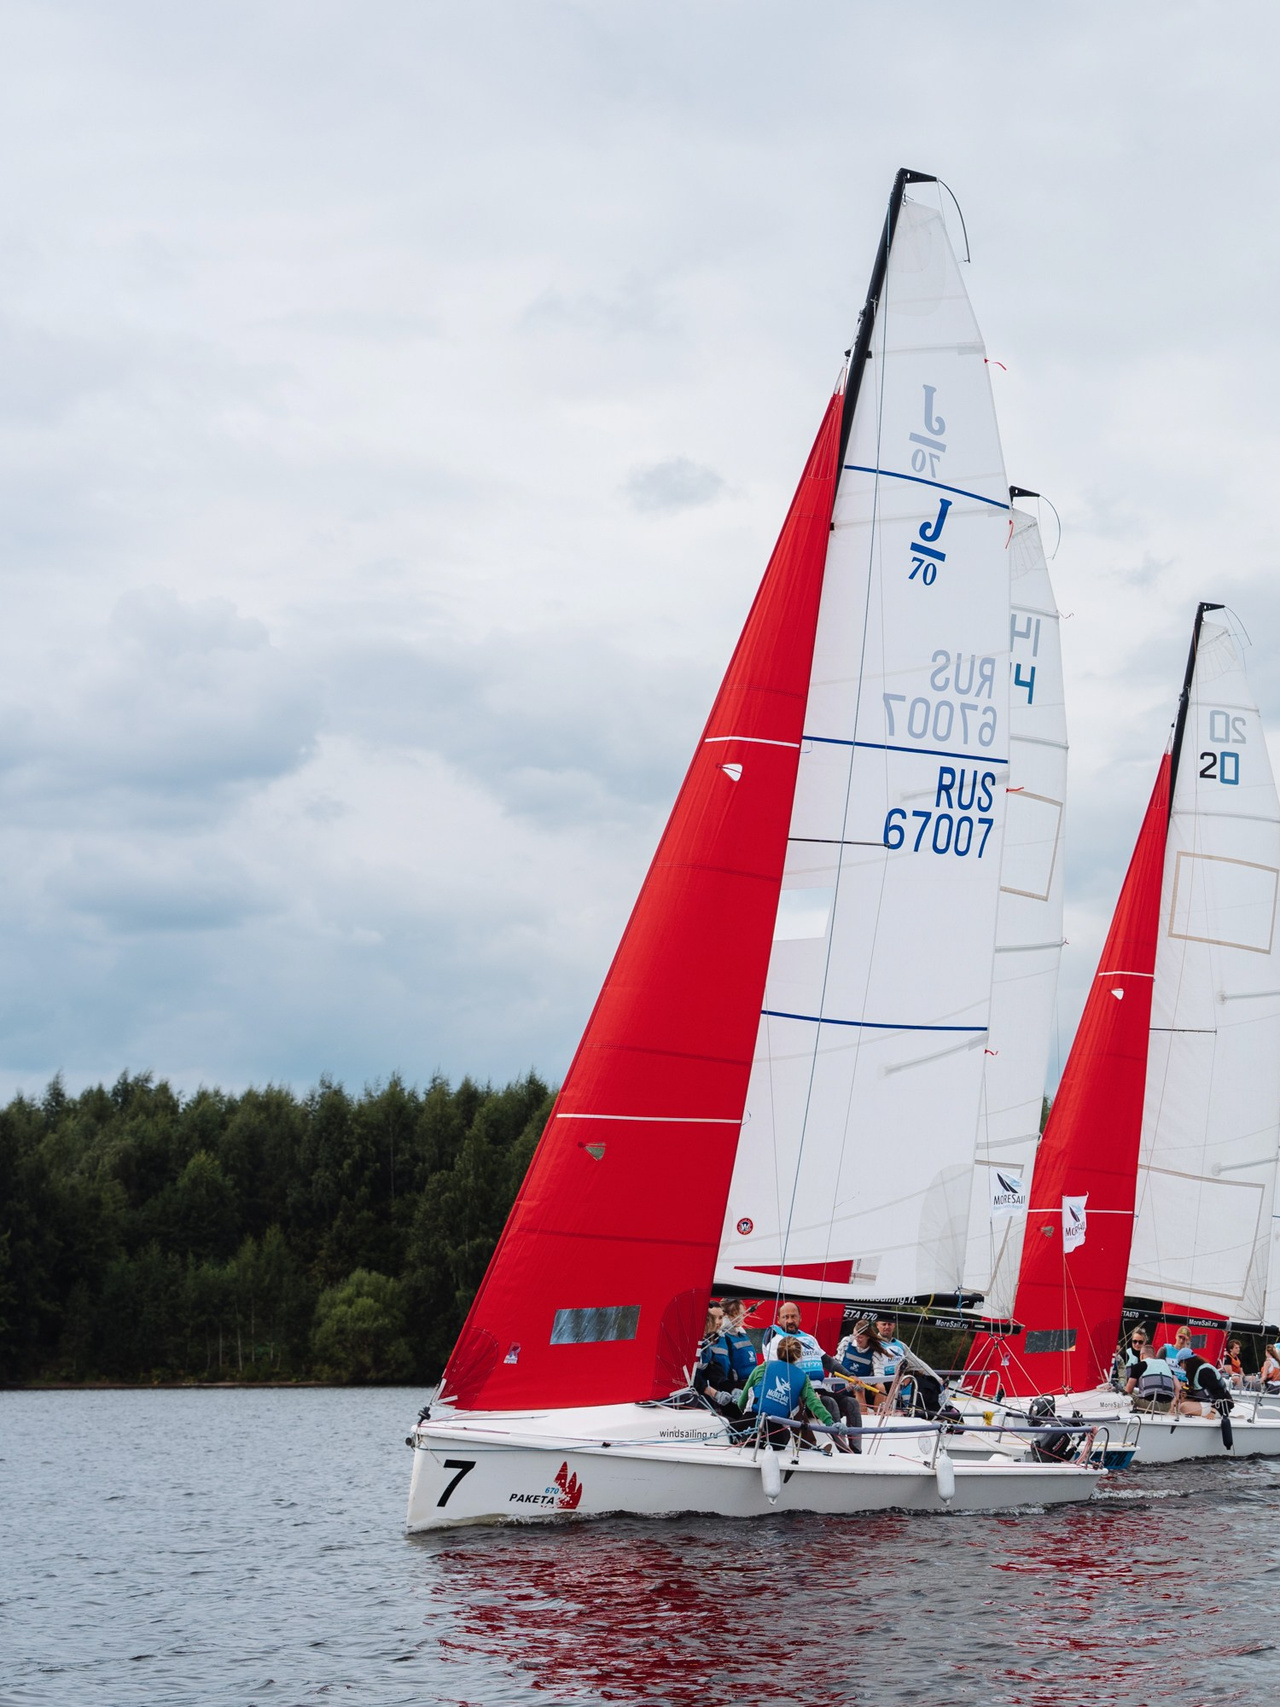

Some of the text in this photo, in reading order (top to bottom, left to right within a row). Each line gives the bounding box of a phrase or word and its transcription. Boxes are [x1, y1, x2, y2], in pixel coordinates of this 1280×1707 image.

[918, 498, 951, 542] J
[908, 556, 937, 586] 70
[1010, 662, 1036, 704] 4
[1199, 751, 1240, 786] 20
[935, 765, 997, 813] RUS
[884, 808, 995, 859] 67007
[843, 1308, 879, 1321] ЕТА 670
[935, 1319, 969, 1329] MoreSail.ru
[1188, 1318, 1218, 1328] MoreSail.ru
[659, 1428, 719, 1440] windsailingru
[436, 1459, 476, 1507] 7
[544, 1486, 560, 1495] 670
[509, 1493, 555, 1505] РАКЕТА
